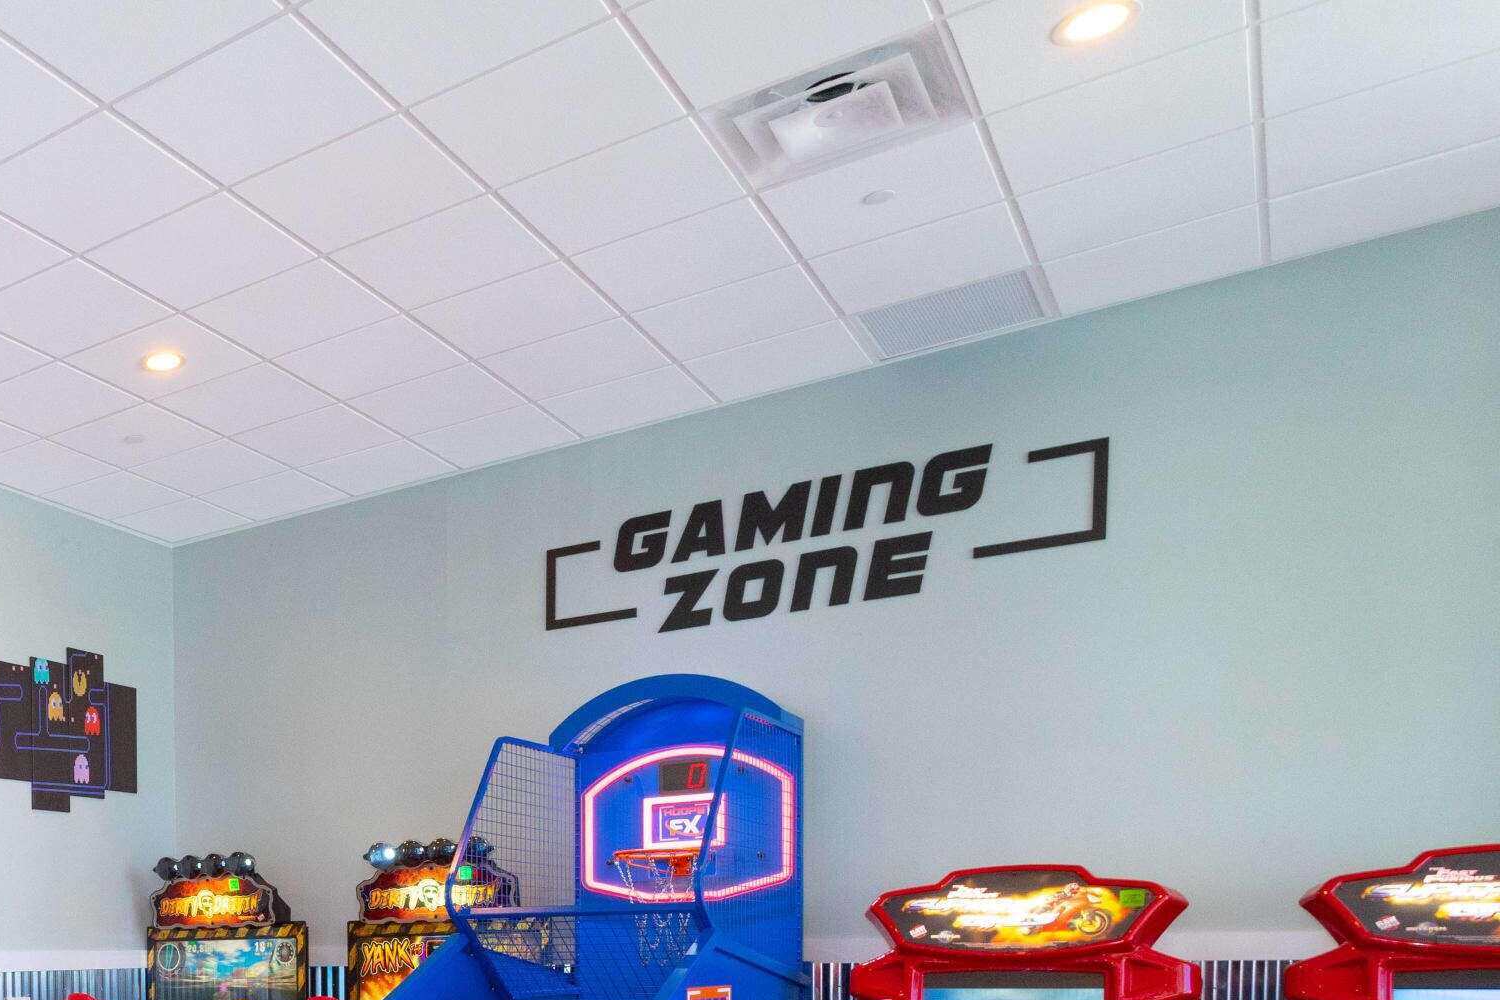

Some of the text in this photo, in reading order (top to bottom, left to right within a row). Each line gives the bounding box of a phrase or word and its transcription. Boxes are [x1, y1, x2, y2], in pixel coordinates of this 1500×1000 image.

[613, 443, 993, 572] GAMING
[658, 531, 933, 633] ZONE
[687, 763, 706, 789] 0
[361, 938, 415, 977] YANK
